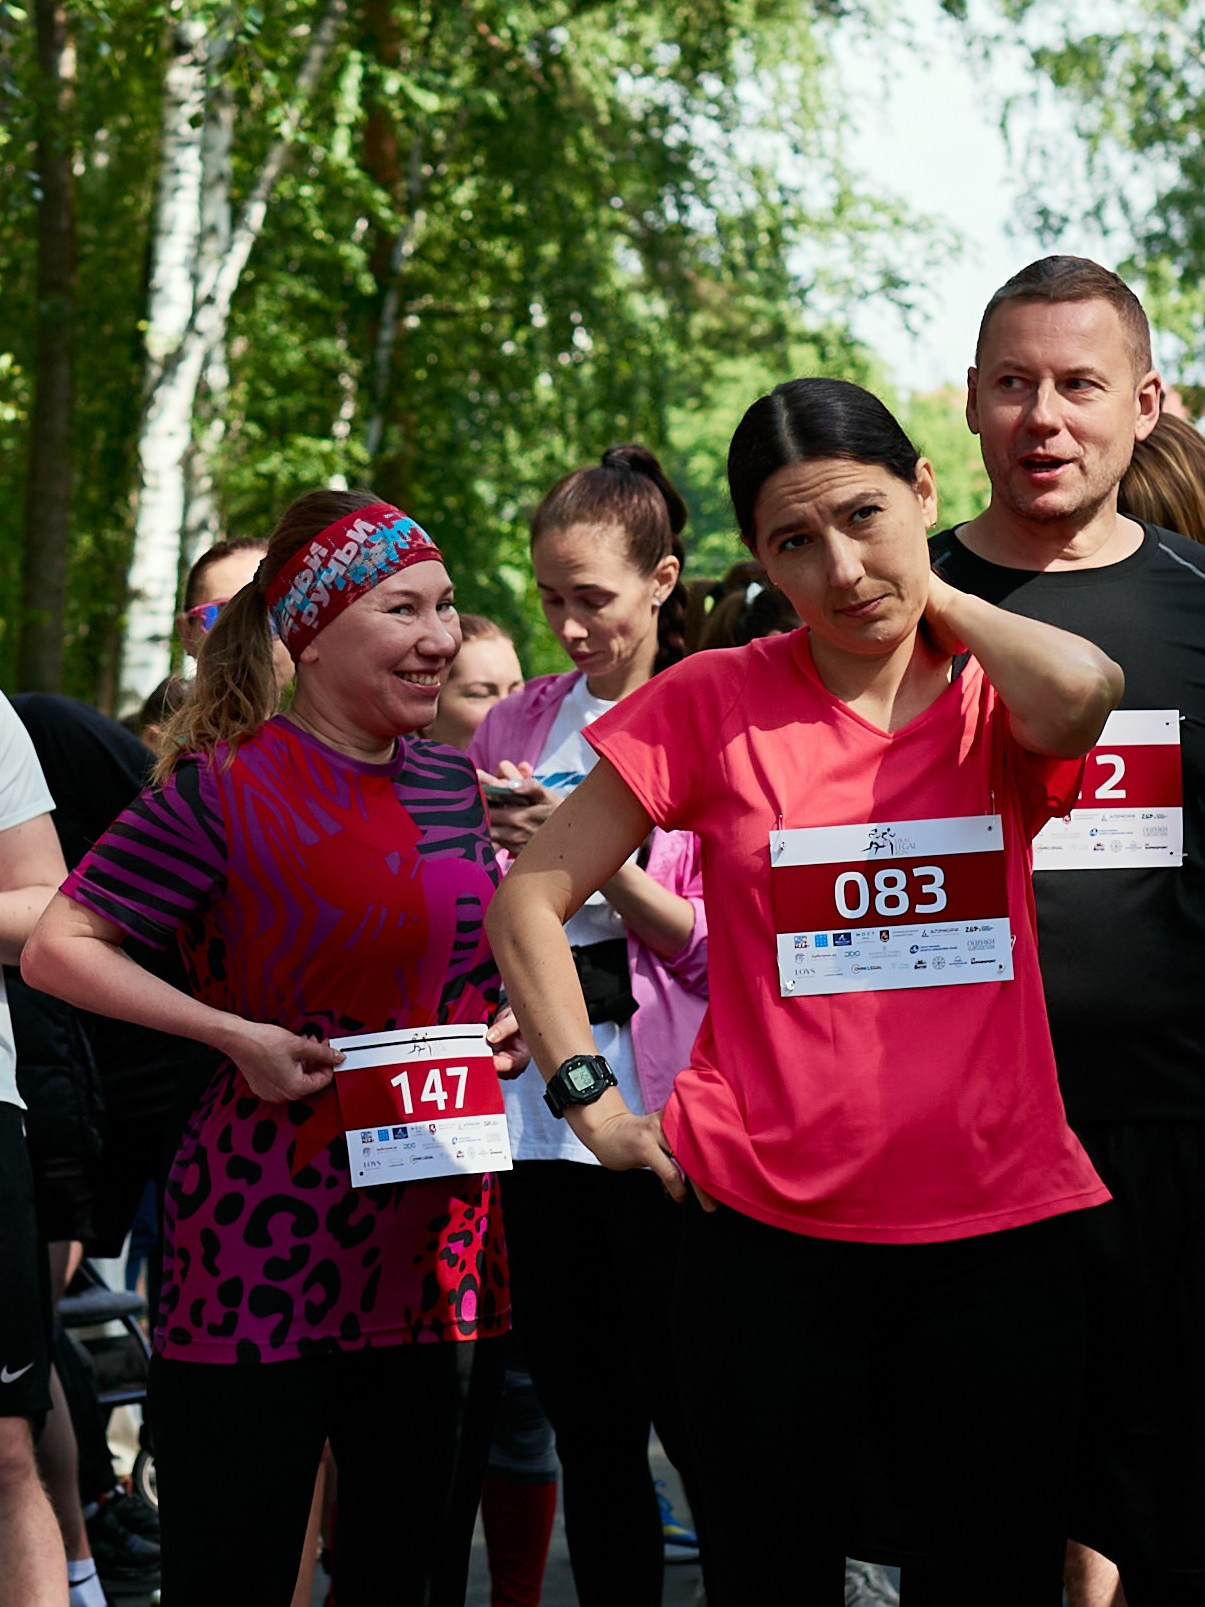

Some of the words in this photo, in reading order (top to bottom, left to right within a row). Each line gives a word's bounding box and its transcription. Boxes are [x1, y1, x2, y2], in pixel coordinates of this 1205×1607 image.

[301, 518, 376, 629] РУЧЬИ
[1077, 754, 1127, 799] 2
[834, 865, 947, 919] 083
[390, 1066, 468, 1114] 147
